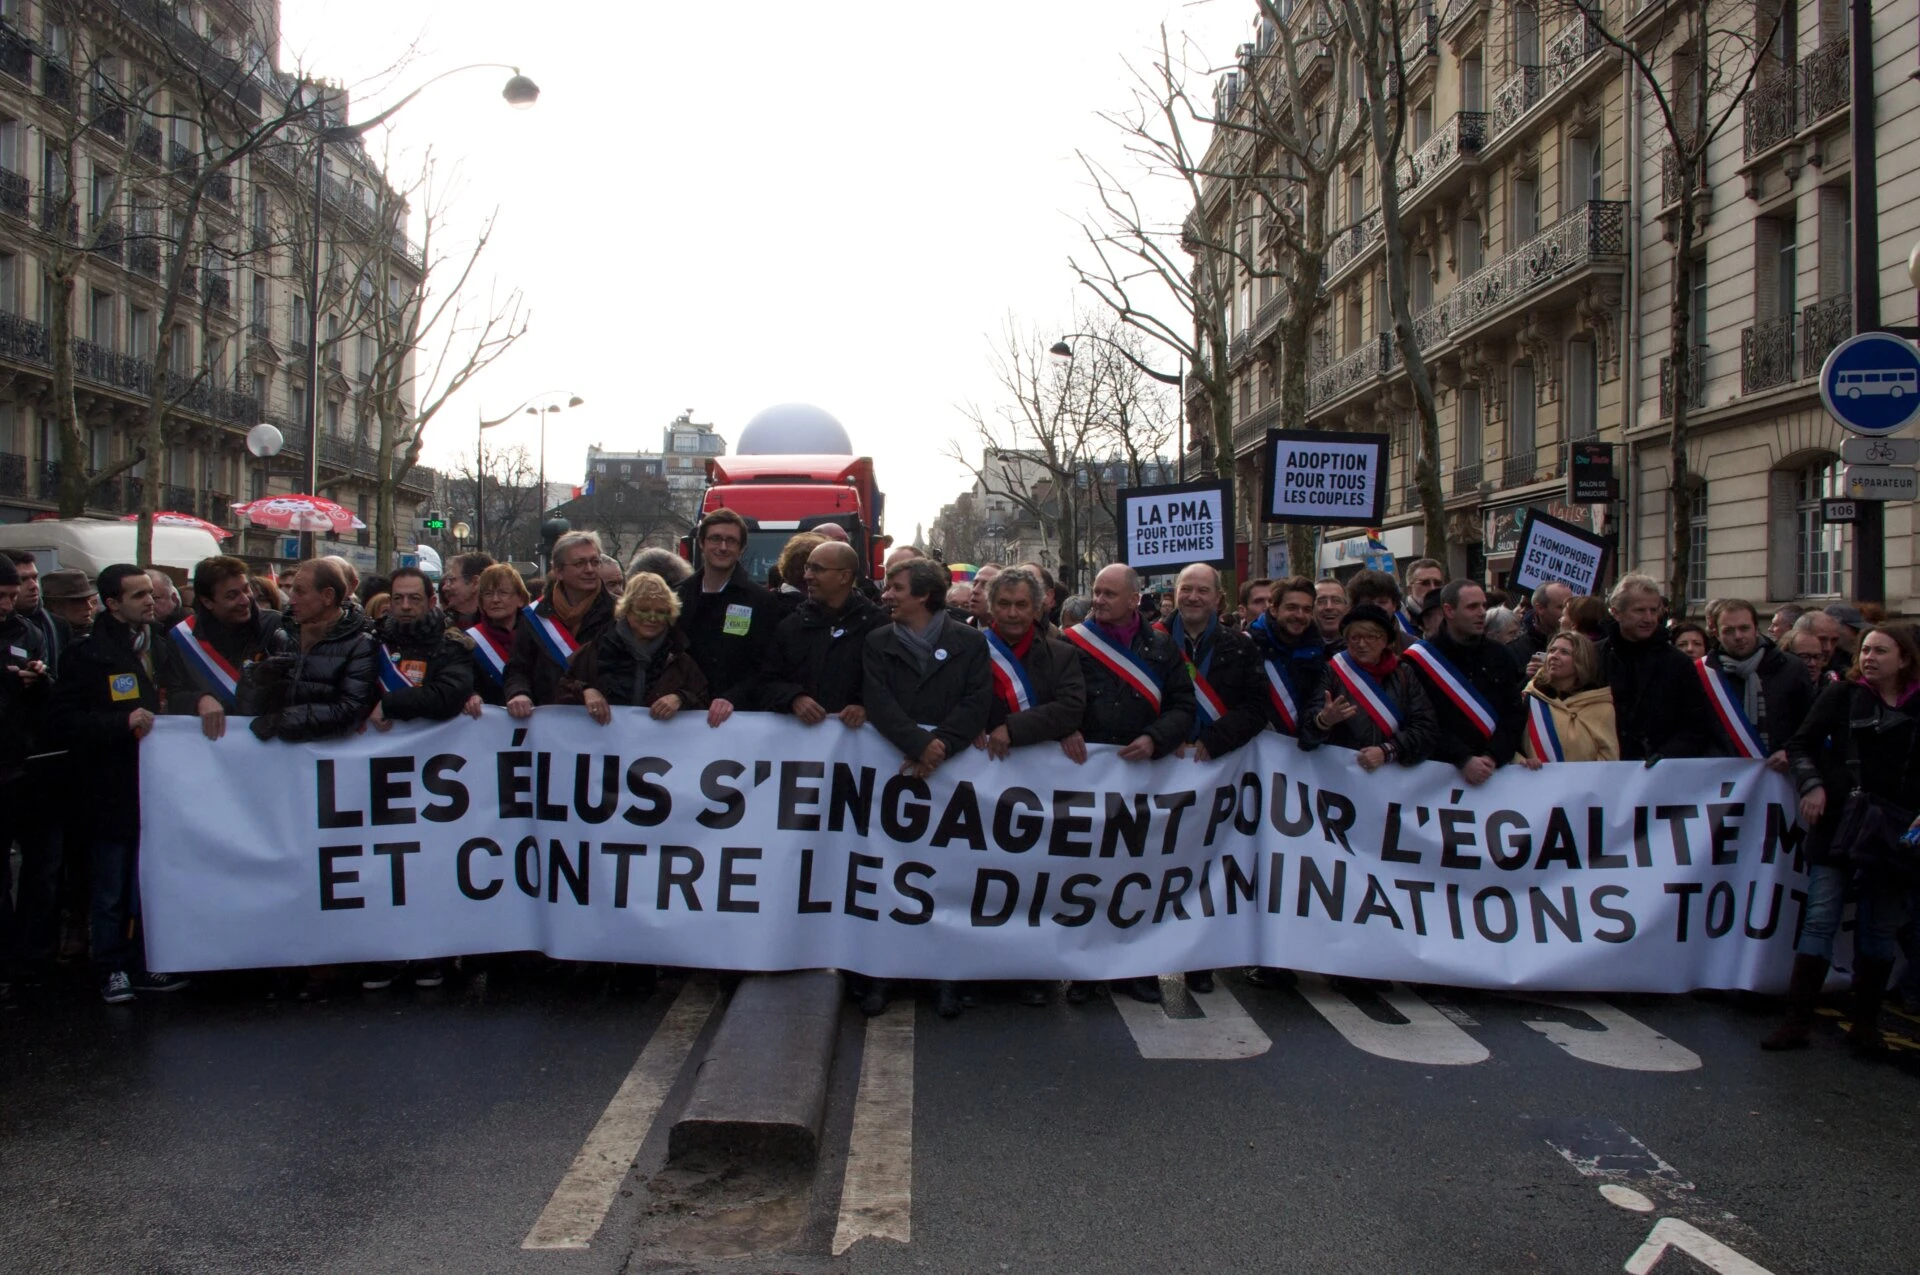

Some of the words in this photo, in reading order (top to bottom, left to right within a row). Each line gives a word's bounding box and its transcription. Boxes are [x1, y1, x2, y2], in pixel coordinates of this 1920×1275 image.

[1286, 451, 1367, 471] ADOPTION
[1285, 472, 1325, 489] POUR
[1329, 473, 1366, 490] TOUS
[1851, 476, 1913, 488] SÉPARATEUR
[1284, 490, 1306, 504] LES
[1309, 490, 1365, 506] COUPLES
[1137, 504, 1163, 526] LA
[1167, 499, 1212, 524] PMA
[1831, 505, 1854, 516] 106
[1136, 526, 1168, 541] POUR
[1170, 521, 1214, 538] TOUTES
[1137, 540, 1160, 556] LES
[1162, 536, 1214, 554] FEMMES
[1532, 533, 1596, 568] L'HOMOPHOBIE
[1524, 564, 1540, 578] PAS
[1528, 548, 1548, 566] EST
[1548, 556, 1563, 573] UN
[1563, 563, 1592, 584] DÉLIT
[315, 753, 470, 829] LES
[496, 727, 673, 827] ÉLUS
[694, 758, 1197, 858] S'ENGAGENT
[1202, 771, 1357, 857] POUR
[1380, 781, 1746, 871] L'ÉGALITÉ
[317, 840, 421, 911] ET
[455, 834, 763, 914] CONTRE
[796, 848, 938, 926] LES
[969, 851, 1638, 944] DISCRIMINATIONS
